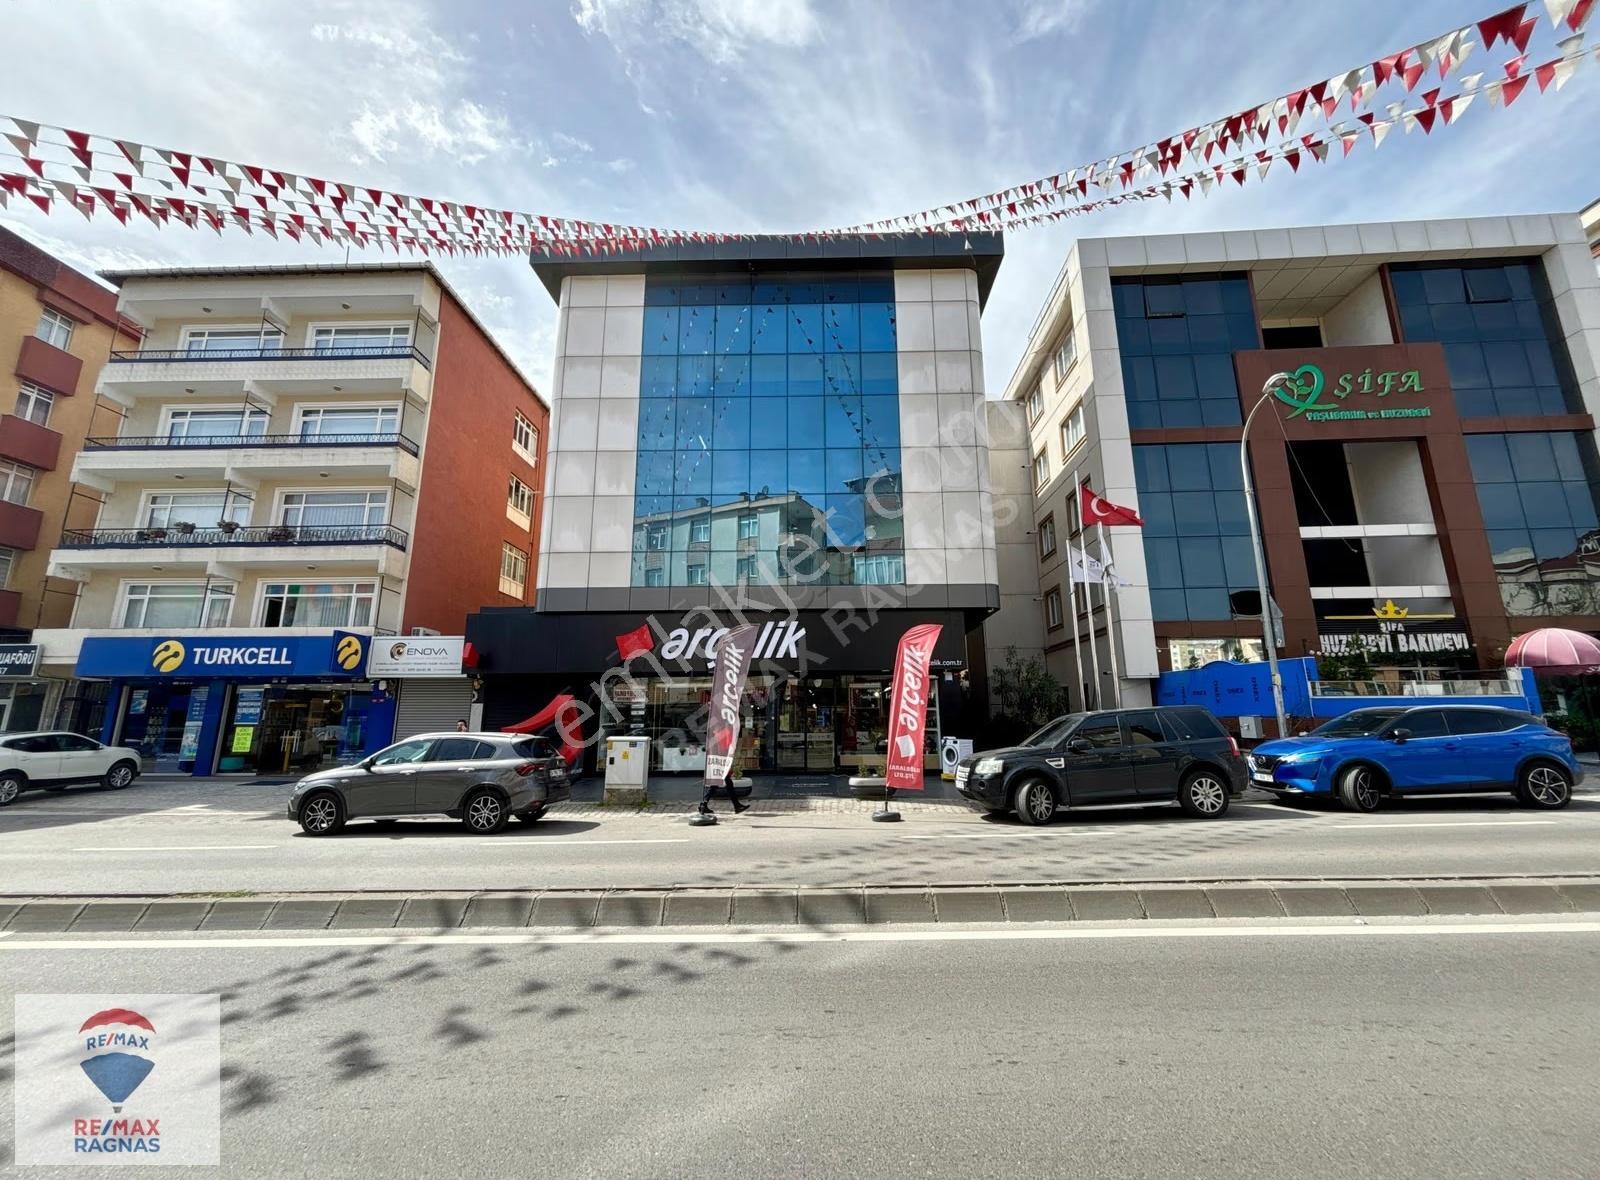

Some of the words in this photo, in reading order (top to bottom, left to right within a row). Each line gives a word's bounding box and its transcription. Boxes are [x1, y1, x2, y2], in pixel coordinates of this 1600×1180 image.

[1333, 367, 1425, 398] ŞİFA
[192, 646, 293, 666] TURKCELL
[661, 620, 807, 670] arçlik
[898, 643, 928, 732] arçelik
